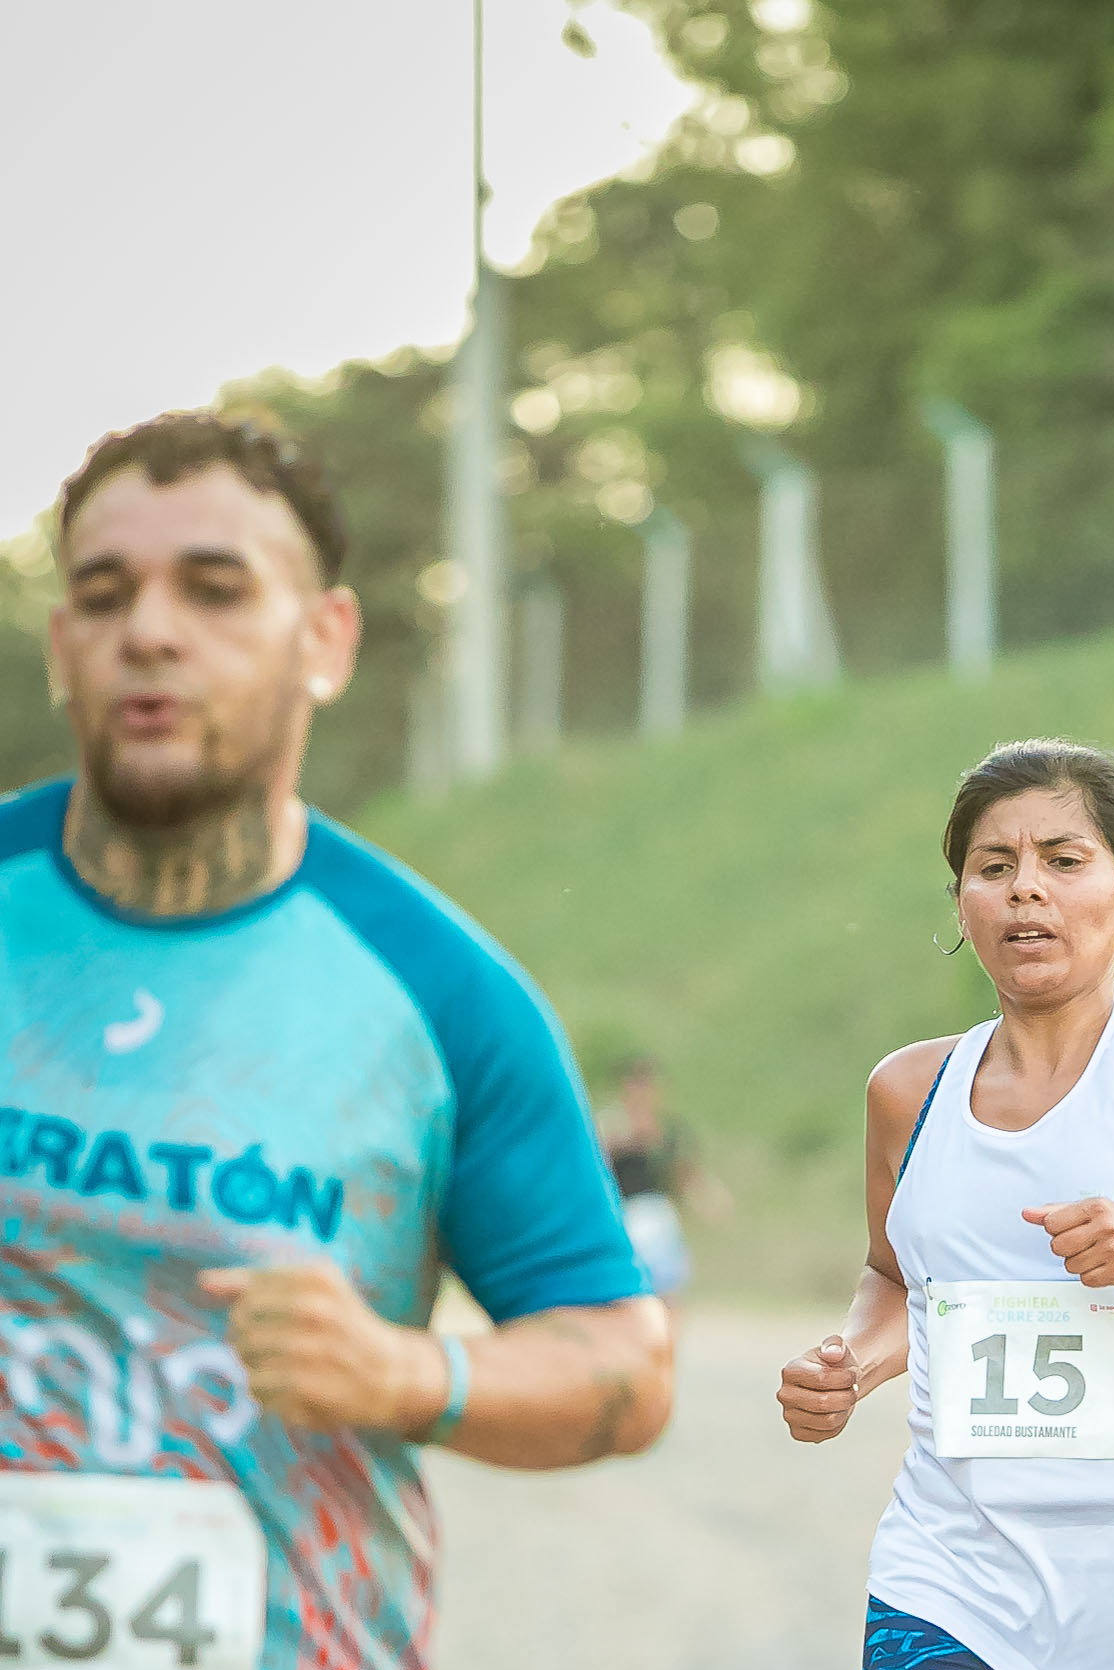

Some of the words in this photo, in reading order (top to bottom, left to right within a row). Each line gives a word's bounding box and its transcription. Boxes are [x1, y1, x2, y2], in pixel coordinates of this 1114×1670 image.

[1038, 1311, 1071, 1323] 2026
[970, 1334, 1086, 1415] 15
[971, 1425, 1012, 1437] SOLEDAD
[1015, 1425, 1077, 1438] BUSTAMANTE
